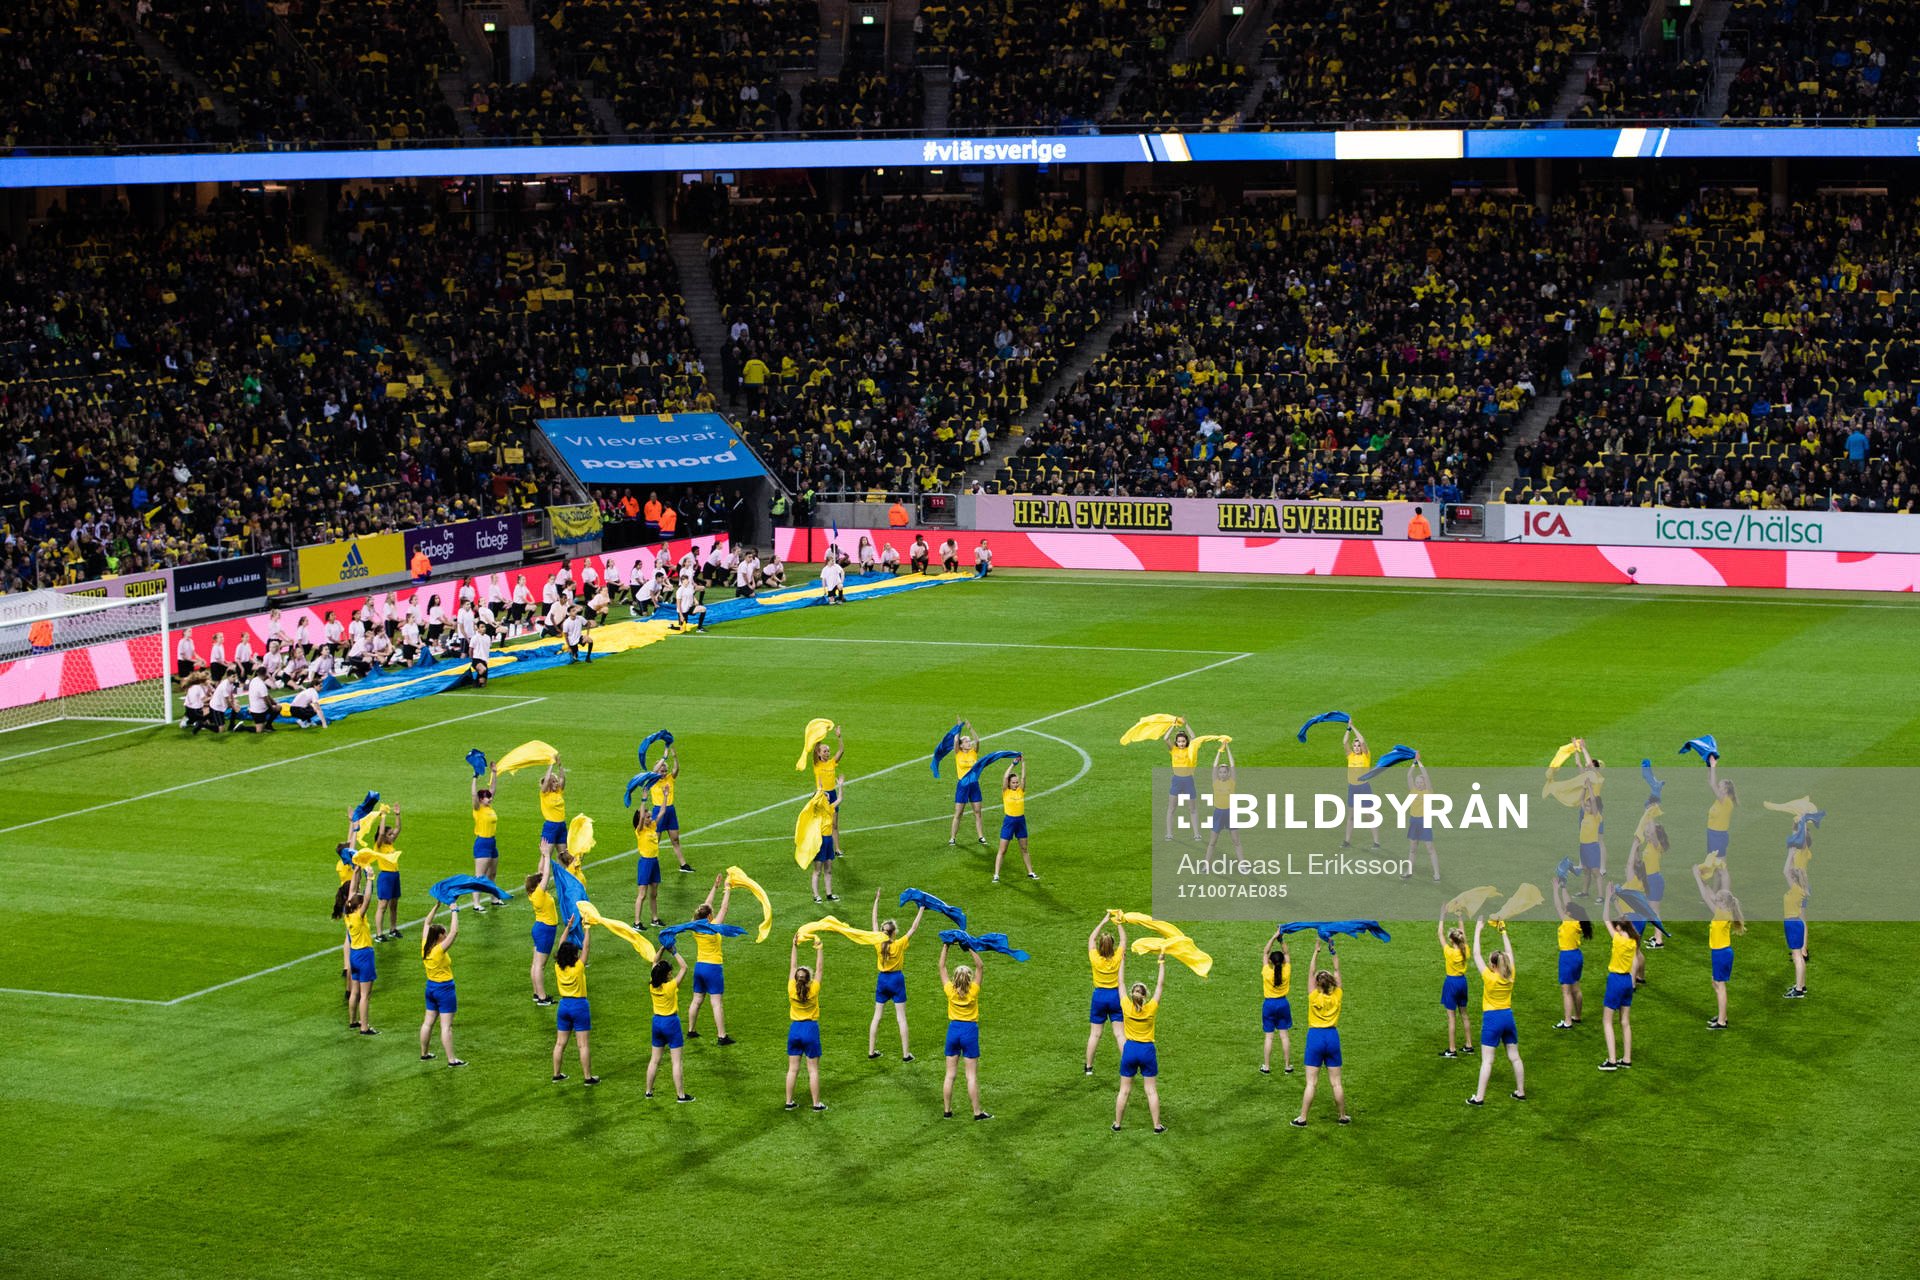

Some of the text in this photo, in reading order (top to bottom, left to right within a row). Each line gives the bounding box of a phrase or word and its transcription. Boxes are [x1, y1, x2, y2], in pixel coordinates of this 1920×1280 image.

[922, 139, 1067, 163] #viärsverige
[564, 430, 725, 447] Vi levererar.
[580, 450, 738, 469] postnord
[1013, 500, 1172, 530] HEJA SVERIGE
[1218, 503, 1383, 535] HEJA SVERIGE
[1524, 511, 1572, 537] ICA
[1656, 514, 1823, 544] ica.se/hälsa
[420, 540, 455, 560] Fabege
[476, 530, 509, 550] Fabege
[340, 566, 369, 580] adidas
[124, 578, 167, 599] SPORT
